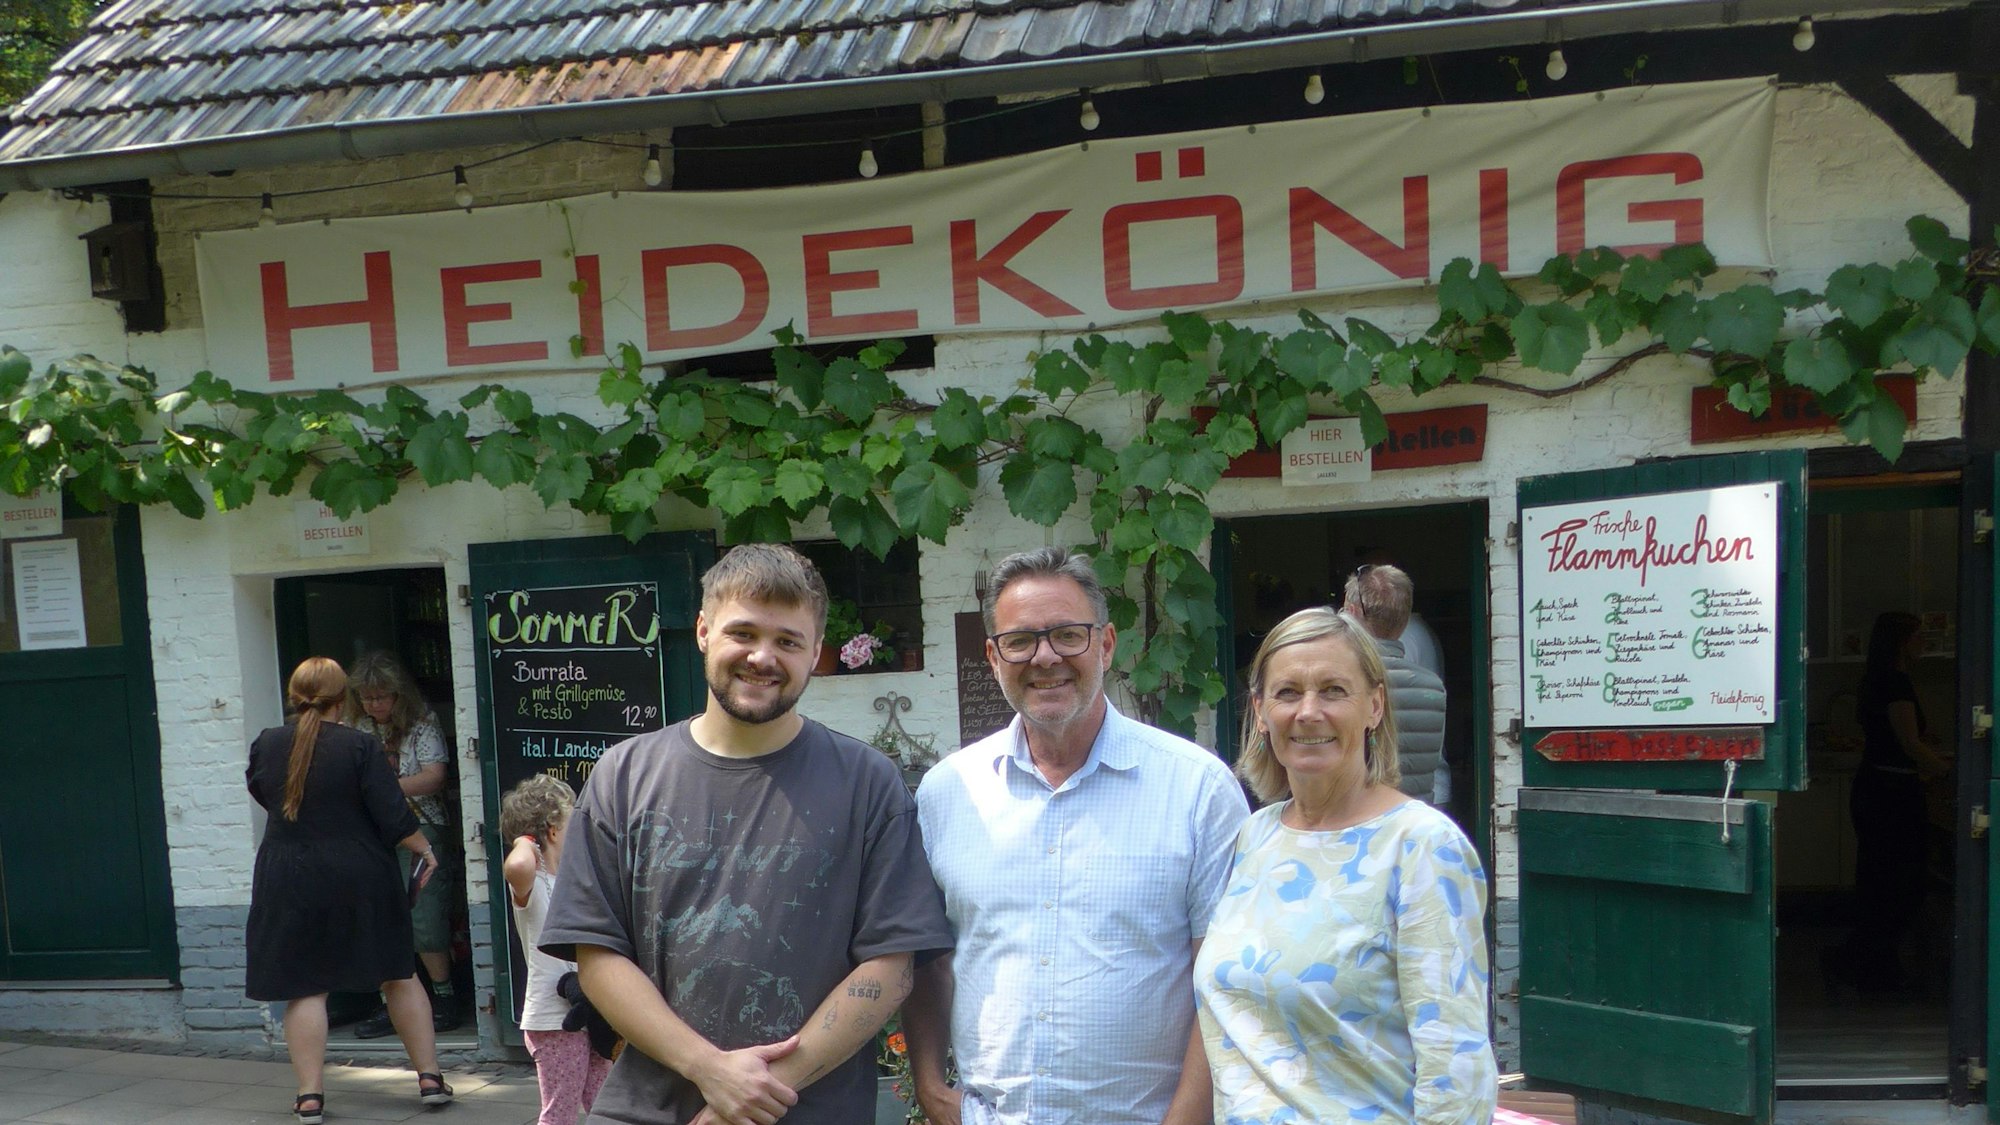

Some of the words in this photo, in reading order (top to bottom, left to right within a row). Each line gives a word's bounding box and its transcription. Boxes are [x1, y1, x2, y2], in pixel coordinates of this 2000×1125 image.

[260, 146, 1704, 382] HEIDEKÖNIG
[1310, 429, 1343, 441] HIER
[1290, 451, 1363, 466] BESTELLEN
[4, 507, 56, 521] BESTELLEN
[1589, 510, 1642, 541] Frische
[304, 526, 363, 540] BESTELLEN
[1541, 514, 1754, 587] Flammkuchen
[1529, 598, 1543, 629] 1
[1604, 592, 1622, 624] 2
[1690, 588, 1708, 618] 3
[1530, 638, 1541, 667] 4
[1586, 646, 1602, 654] und
[1604, 632, 1619, 663] 5
[1659, 642, 1675, 650] und
[1692, 626, 1708, 659] 6
[1739, 637, 1759, 645] und
[512, 661, 588, 683] Burrata
[533, 684, 551, 701] mit
[555, 684, 626, 709] Grillgemüse
[1603, 672, 1617, 703] 8
[1663, 686, 1679, 694] und
[518, 697, 529, 716] &
[533, 702, 572, 720] Pesto
[1710, 689, 1764, 712] Heidekönig
[522, 737, 551, 757] ital.
[554, 737, 614, 759] Landsch
[547, 761, 569, 780] mit
